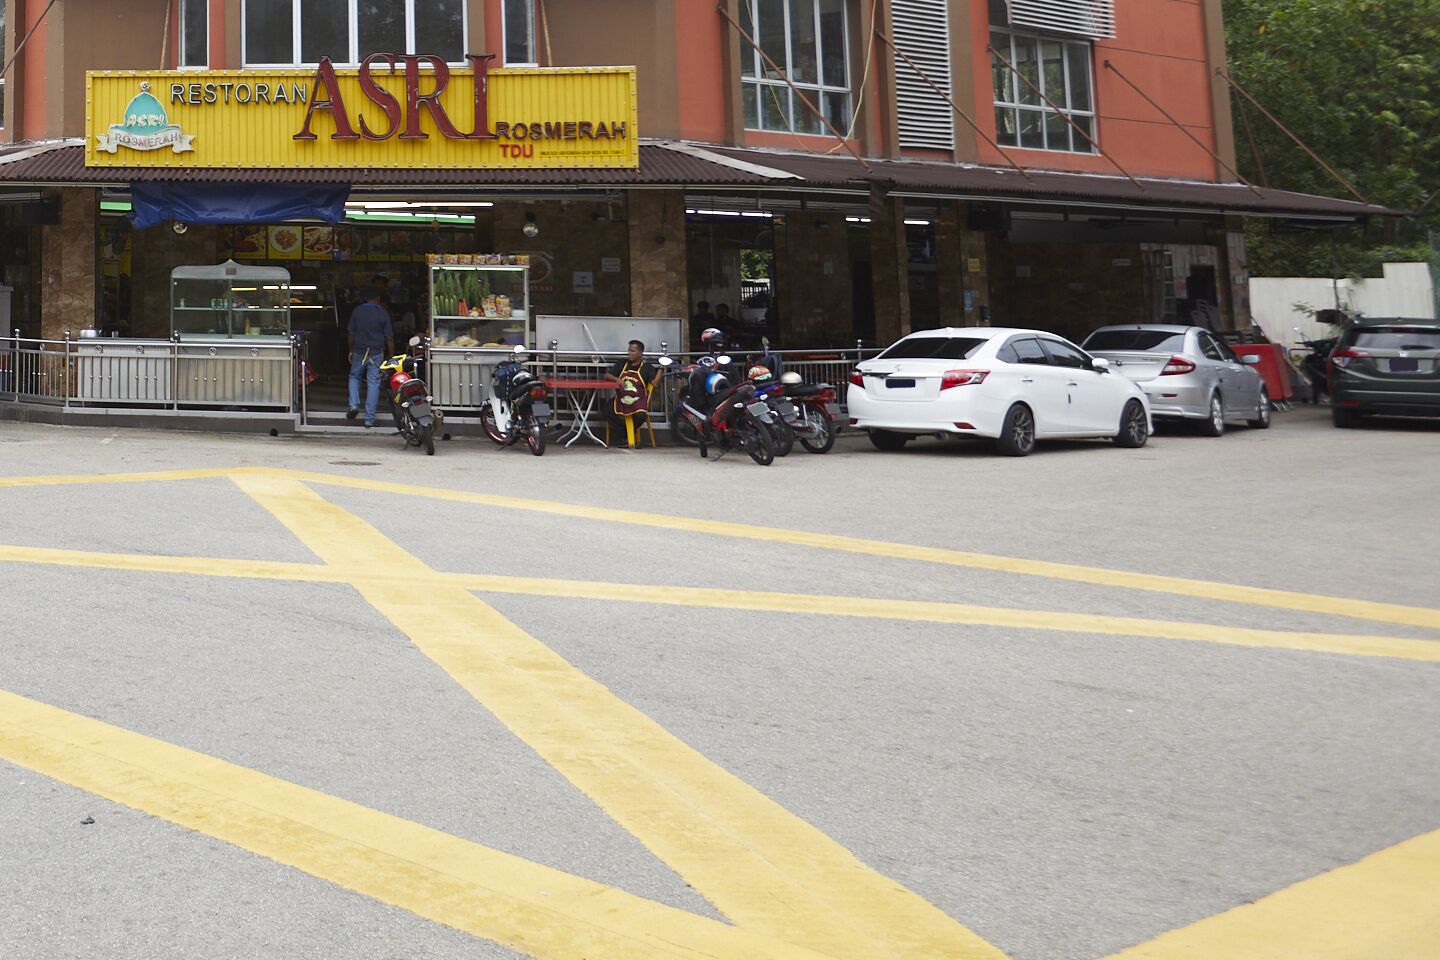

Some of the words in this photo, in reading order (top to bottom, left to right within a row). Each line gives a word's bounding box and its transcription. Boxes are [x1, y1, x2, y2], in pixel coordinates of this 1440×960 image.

[171, 82, 307, 105] RESTORAN
[292, 52, 498, 140] ASRI
[126, 113, 165, 128] ASRI
[496, 121, 627, 140] ROSMERAH
[113, 132, 179, 149] ROSMERAH
[499, 143, 534, 159] TDU
